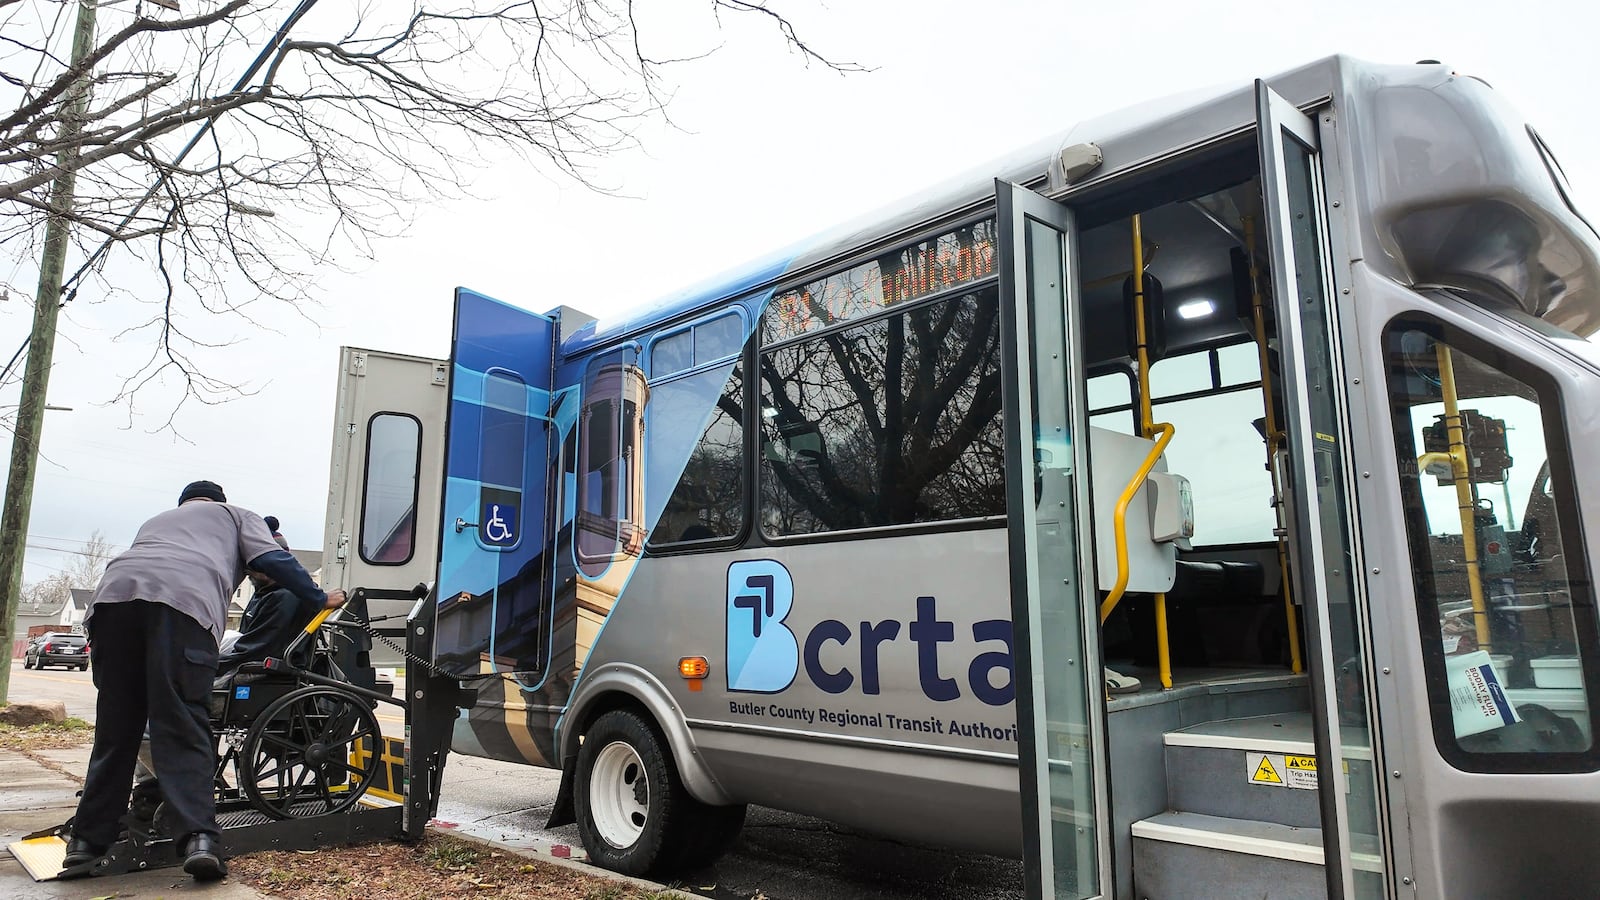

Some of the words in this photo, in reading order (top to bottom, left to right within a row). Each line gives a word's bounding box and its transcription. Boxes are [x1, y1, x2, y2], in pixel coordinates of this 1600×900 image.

[1470, 668, 1487, 693] BODILY
[1483, 694, 1497, 715] FLUID
[729, 701, 766, 716] Butler
[769, 704, 815, 724] County
[819, 708, 883, 728] Regional
[886, 714, 944, 734] Transit
[948, 720, 1019, 742] Authori
